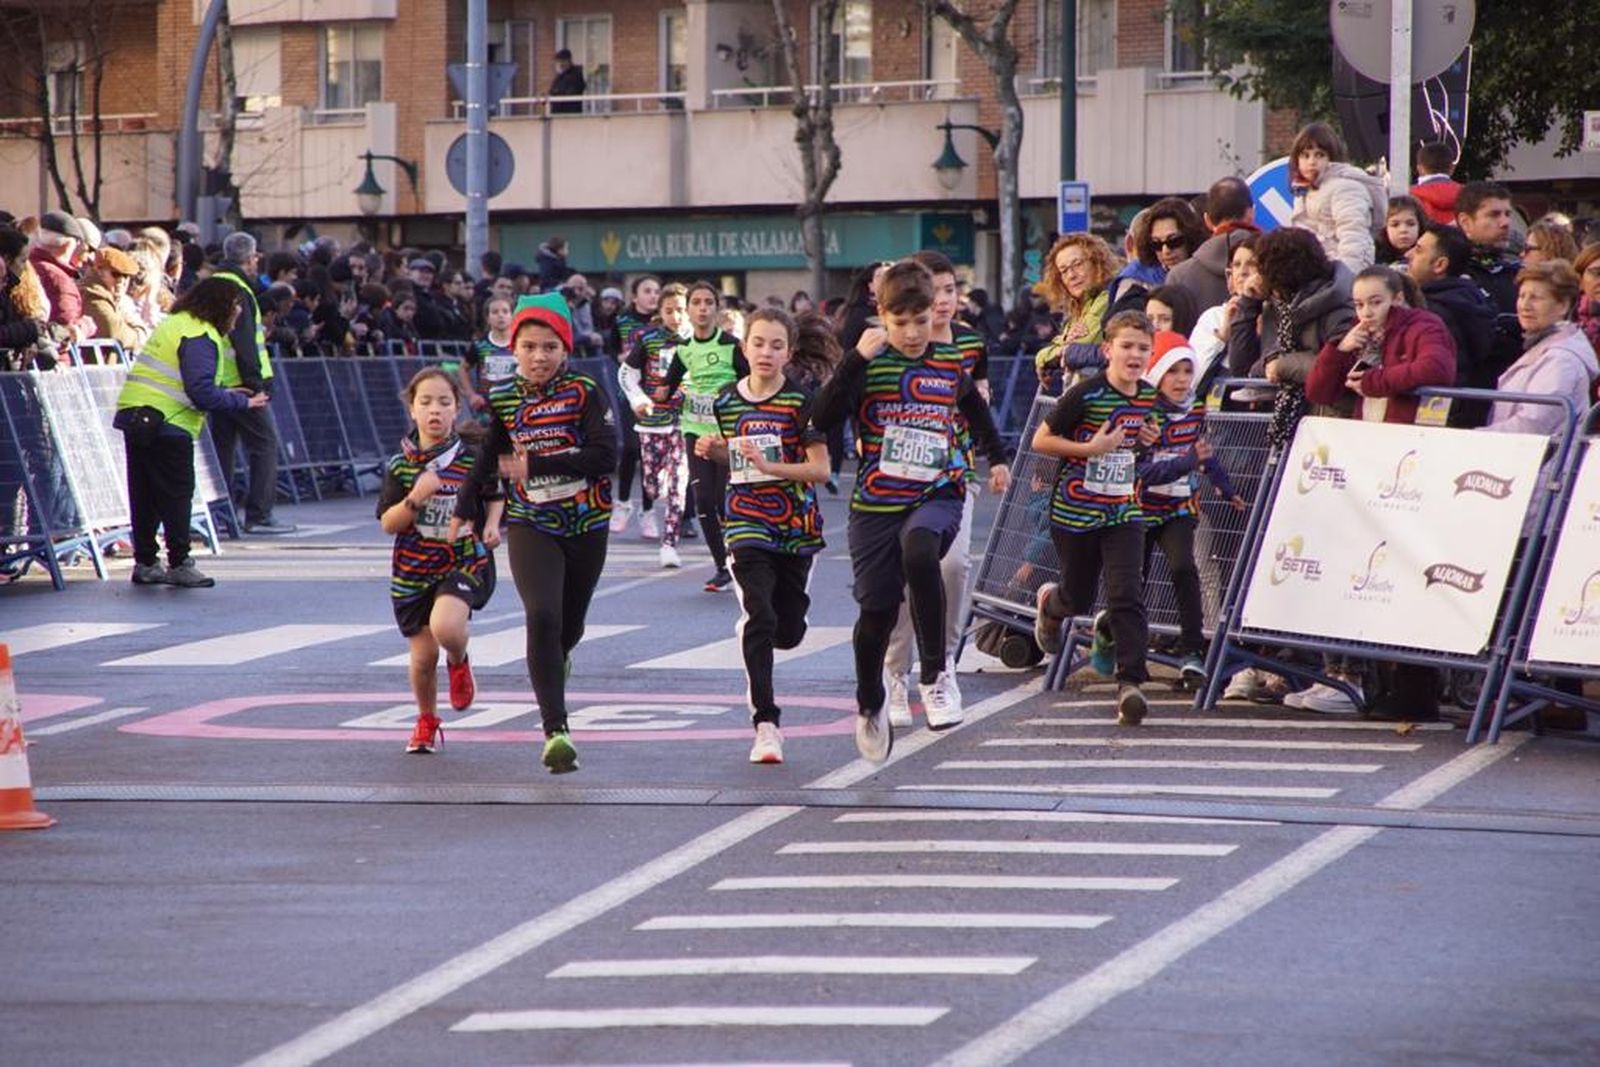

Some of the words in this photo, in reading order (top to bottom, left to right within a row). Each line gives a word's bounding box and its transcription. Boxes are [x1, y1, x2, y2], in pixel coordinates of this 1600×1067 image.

[626, 232, 663, 264] CAJA
[665, 231, 714, 257] RURAL
[718, 230, 738, 256] DE
[742, 229, 841, 256] SALAMACA
[890, 441, 935, 465] 5805
[1095, 463, 1126, 482] 5715
[1308, 466, 1347, 483] SETEL
[1281, 557, 1323, 575] SETEL
